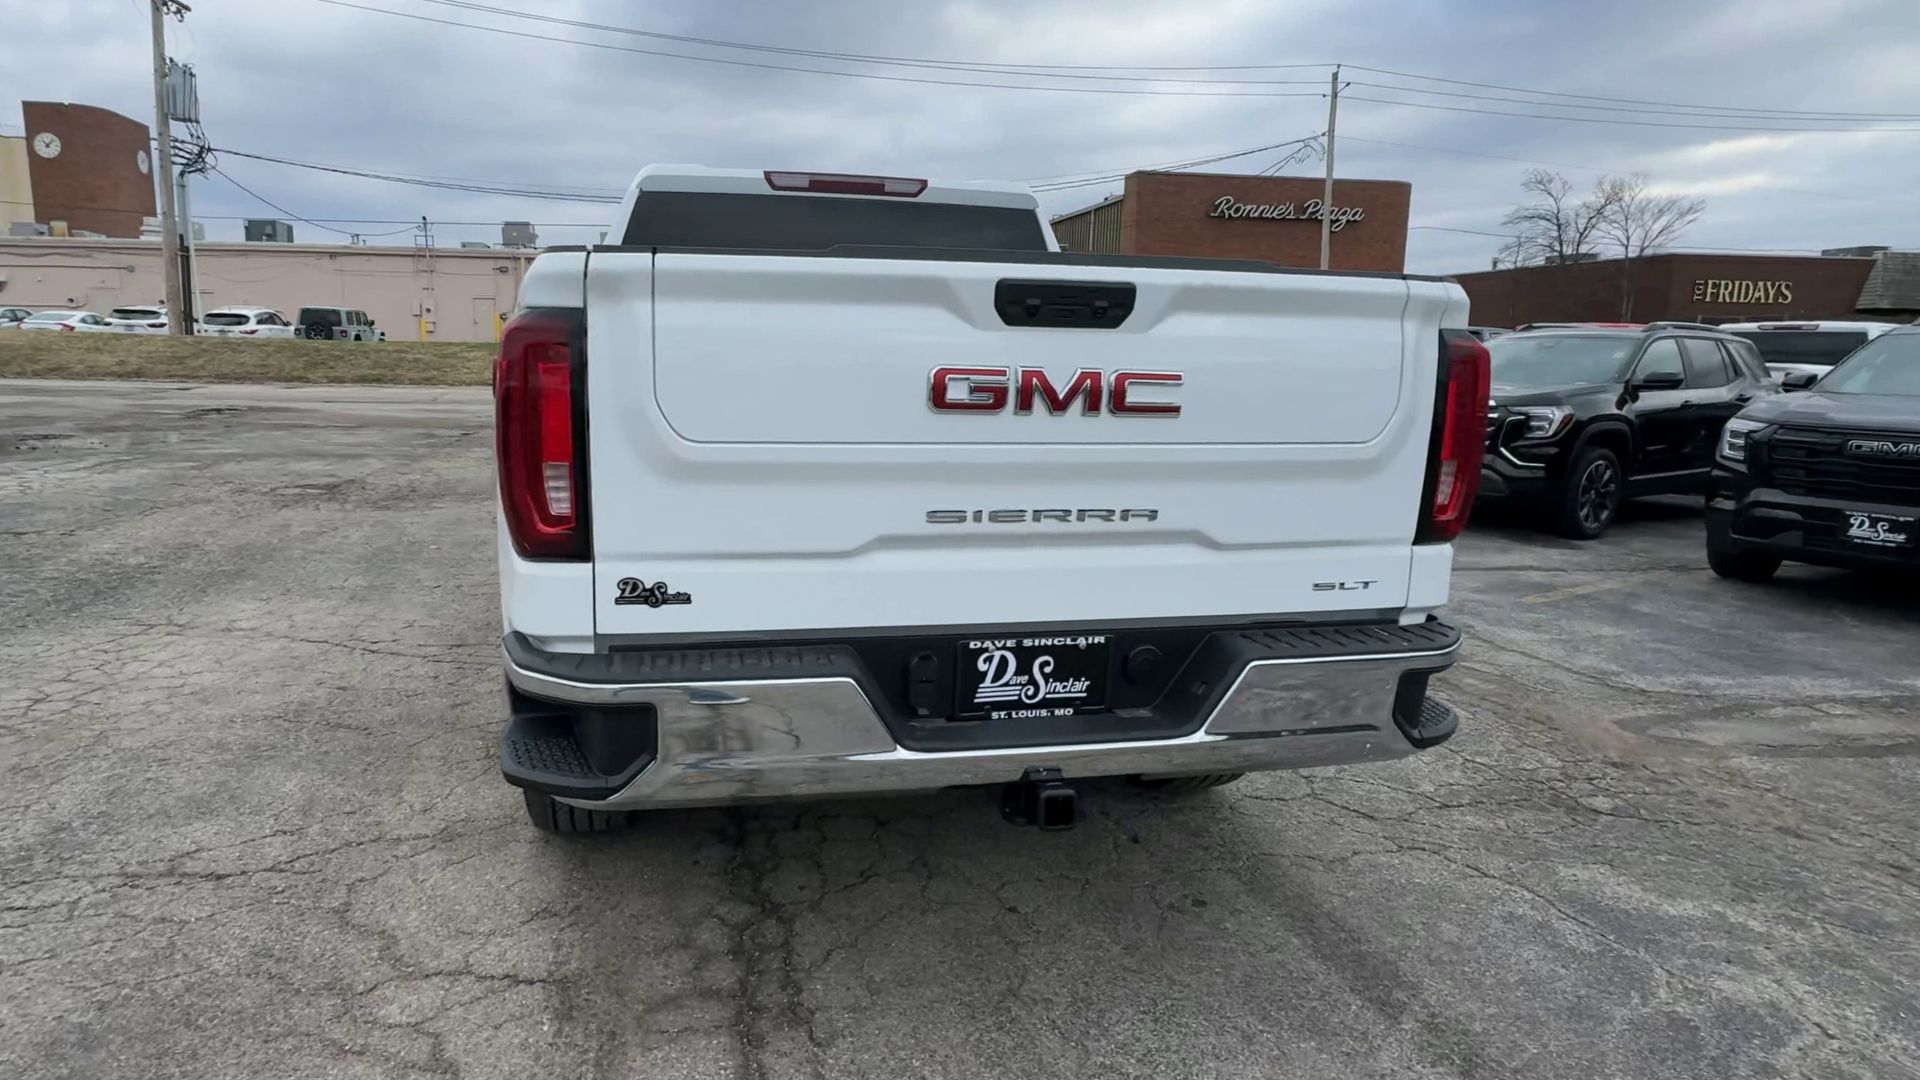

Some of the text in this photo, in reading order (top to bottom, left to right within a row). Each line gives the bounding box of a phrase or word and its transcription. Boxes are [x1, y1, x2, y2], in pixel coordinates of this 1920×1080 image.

[1210, 196, 1296, 219] Ronnie's
[1693, 280, 1705, 301] TGI
[928, 365, 1184, 418] GMC
[1847, 440, 1920, 457] GM
[925, 508, 1159, 524] SIERRA
[1312, 580, 1378, 591] SLT
[968, 636, 1105, 649] DAVE SINCLAIR
[976, 649, 1091, 704] Dave Sinclair
[1055, 708, 1073, 716] MO
